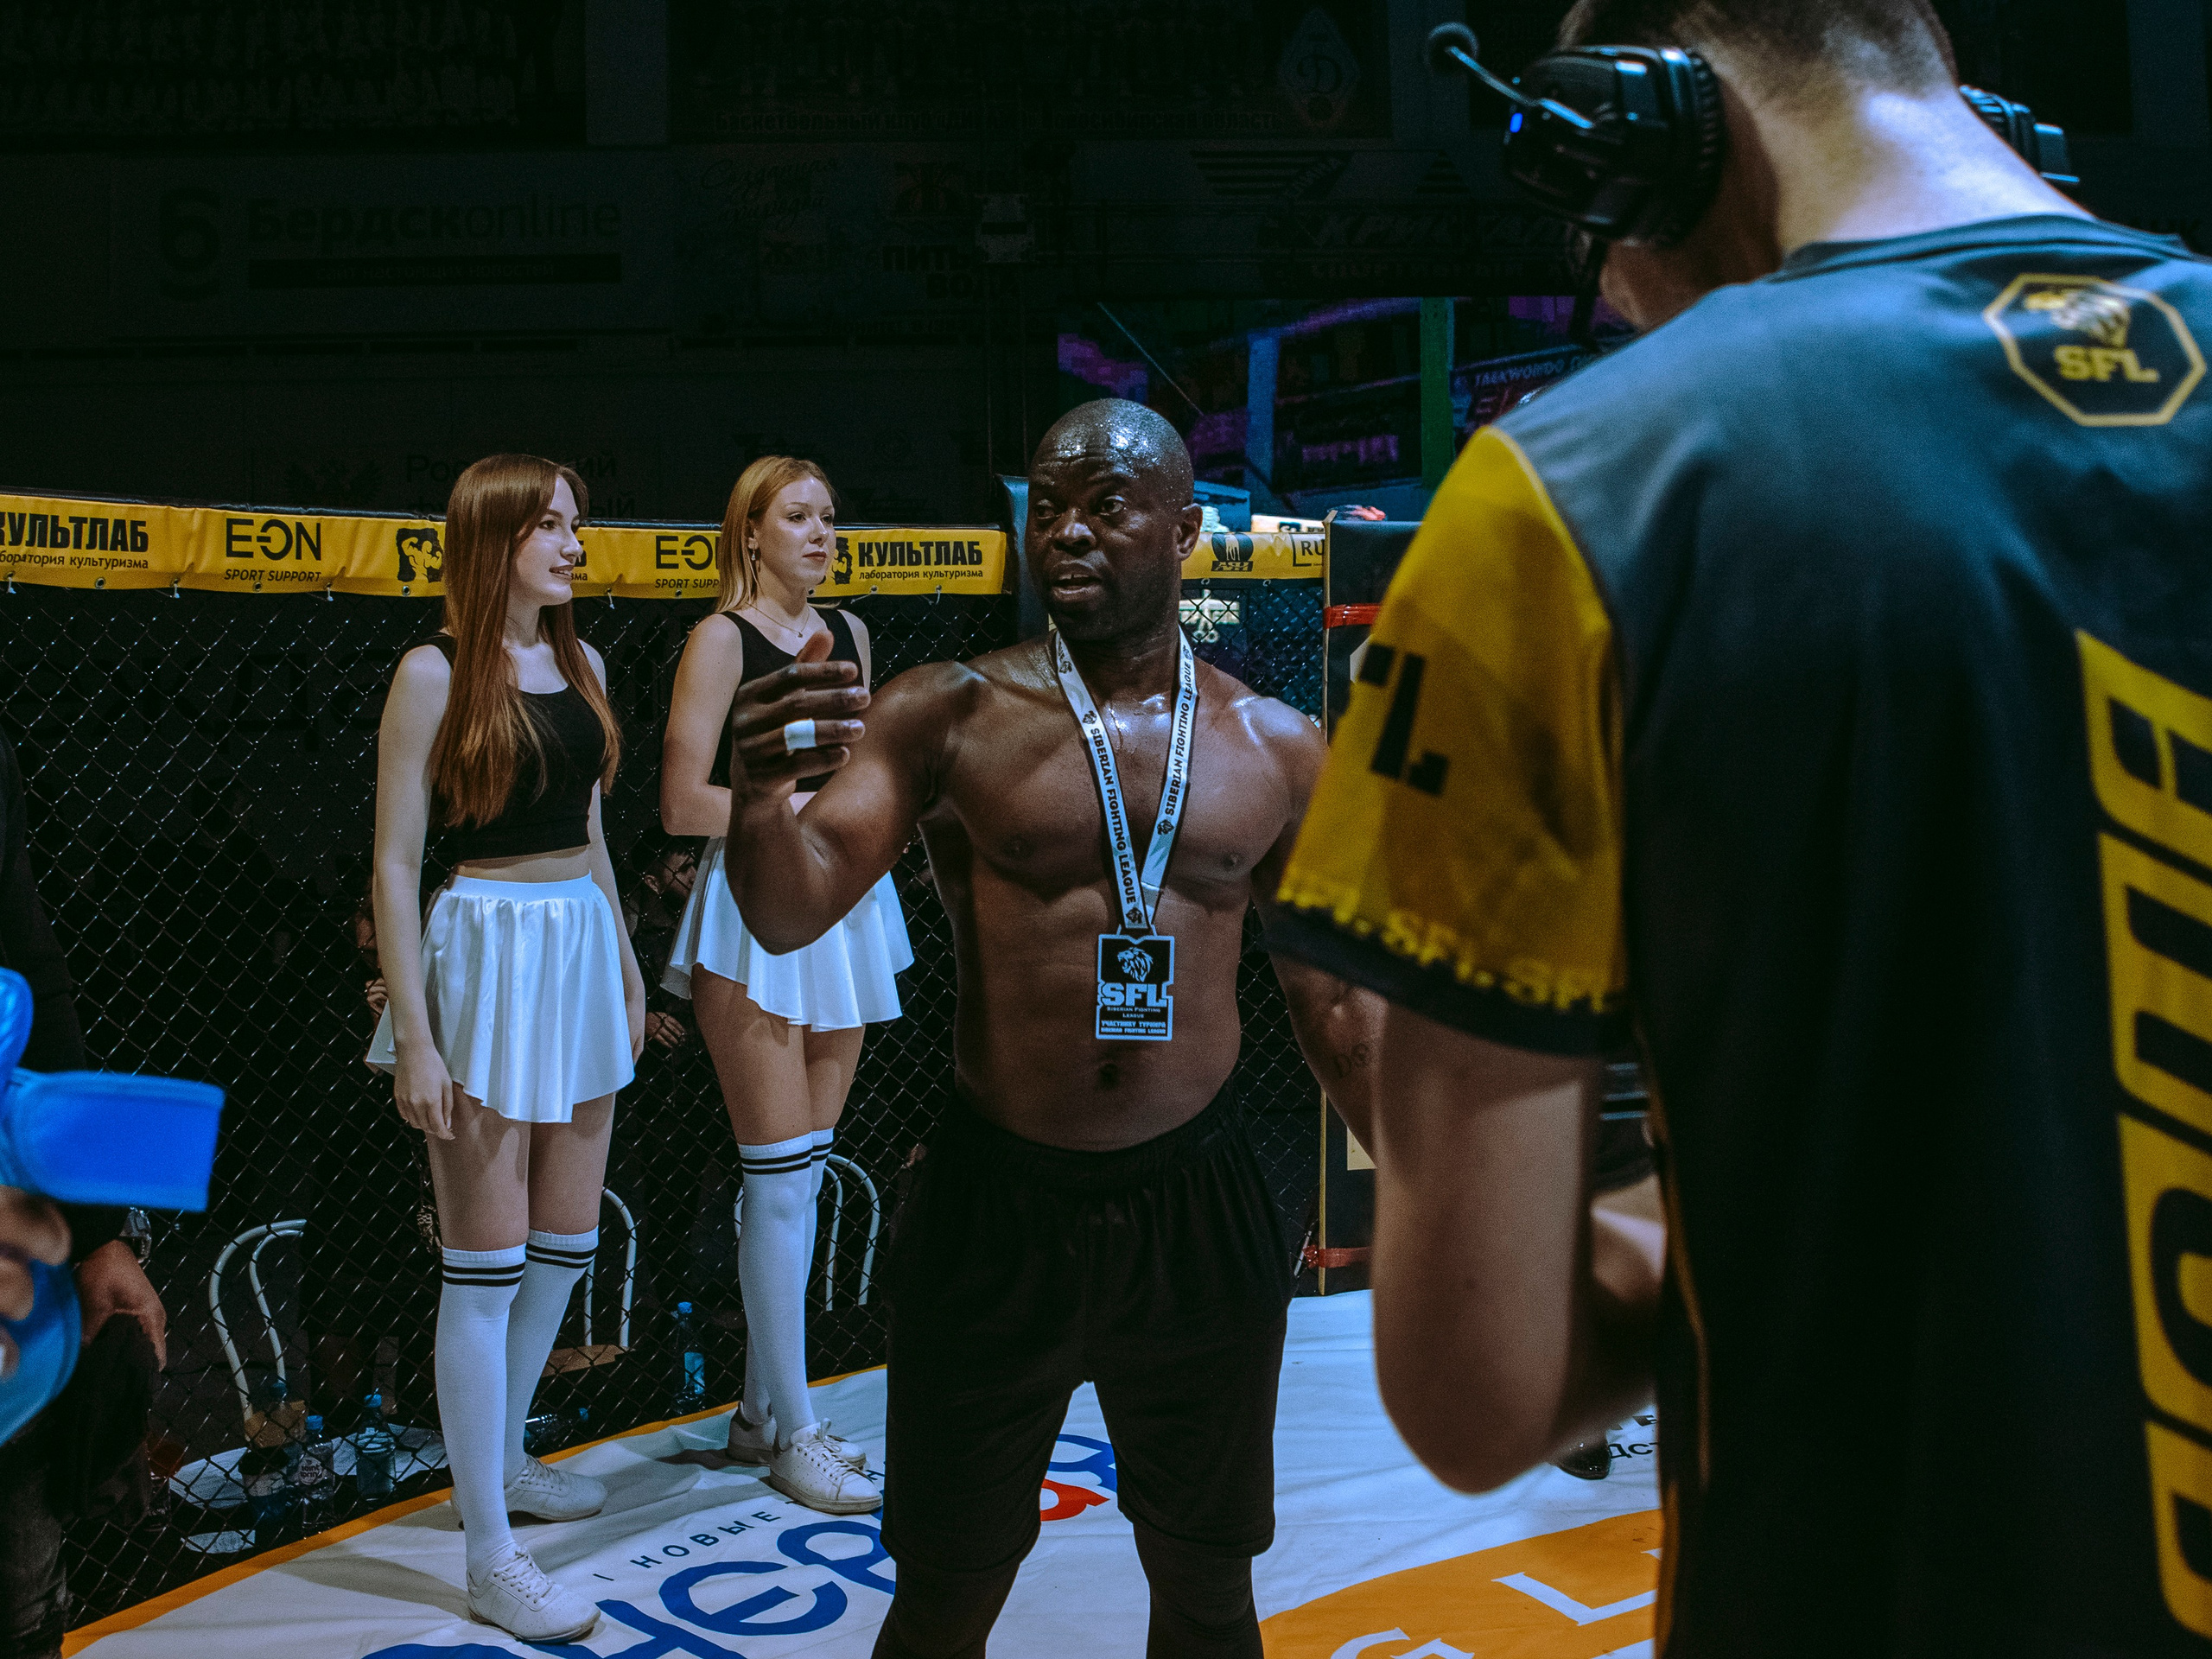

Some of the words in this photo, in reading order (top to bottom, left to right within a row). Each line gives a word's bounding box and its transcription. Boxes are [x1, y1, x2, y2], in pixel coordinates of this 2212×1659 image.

[2053, 345, 2159, 383] SFL
[70, 556, 149, 570] культуризма
[858, 541, 982, 567] КУЛЬТЛАБ
[225, 569, 264, 582] SPORT
[267, 570, 321, 582] SUPPORT
[655, 578, 690, 589] SPORT
[859, 570, 920, 582] лаборатория
[923, 569, 983, 581] культуризма
[1165, 759, 1183, 817] SIBERIAN
[1090, 728, 1115, 785] SIBERIAN
[1106, 788, 1126, 851] FIGHTING
[1118, 854, 1136, 905] LEAGUE
[1101, 982, 1167, 1007] SFL
[629, 1510, 782, 1569] НОВЫЕ
